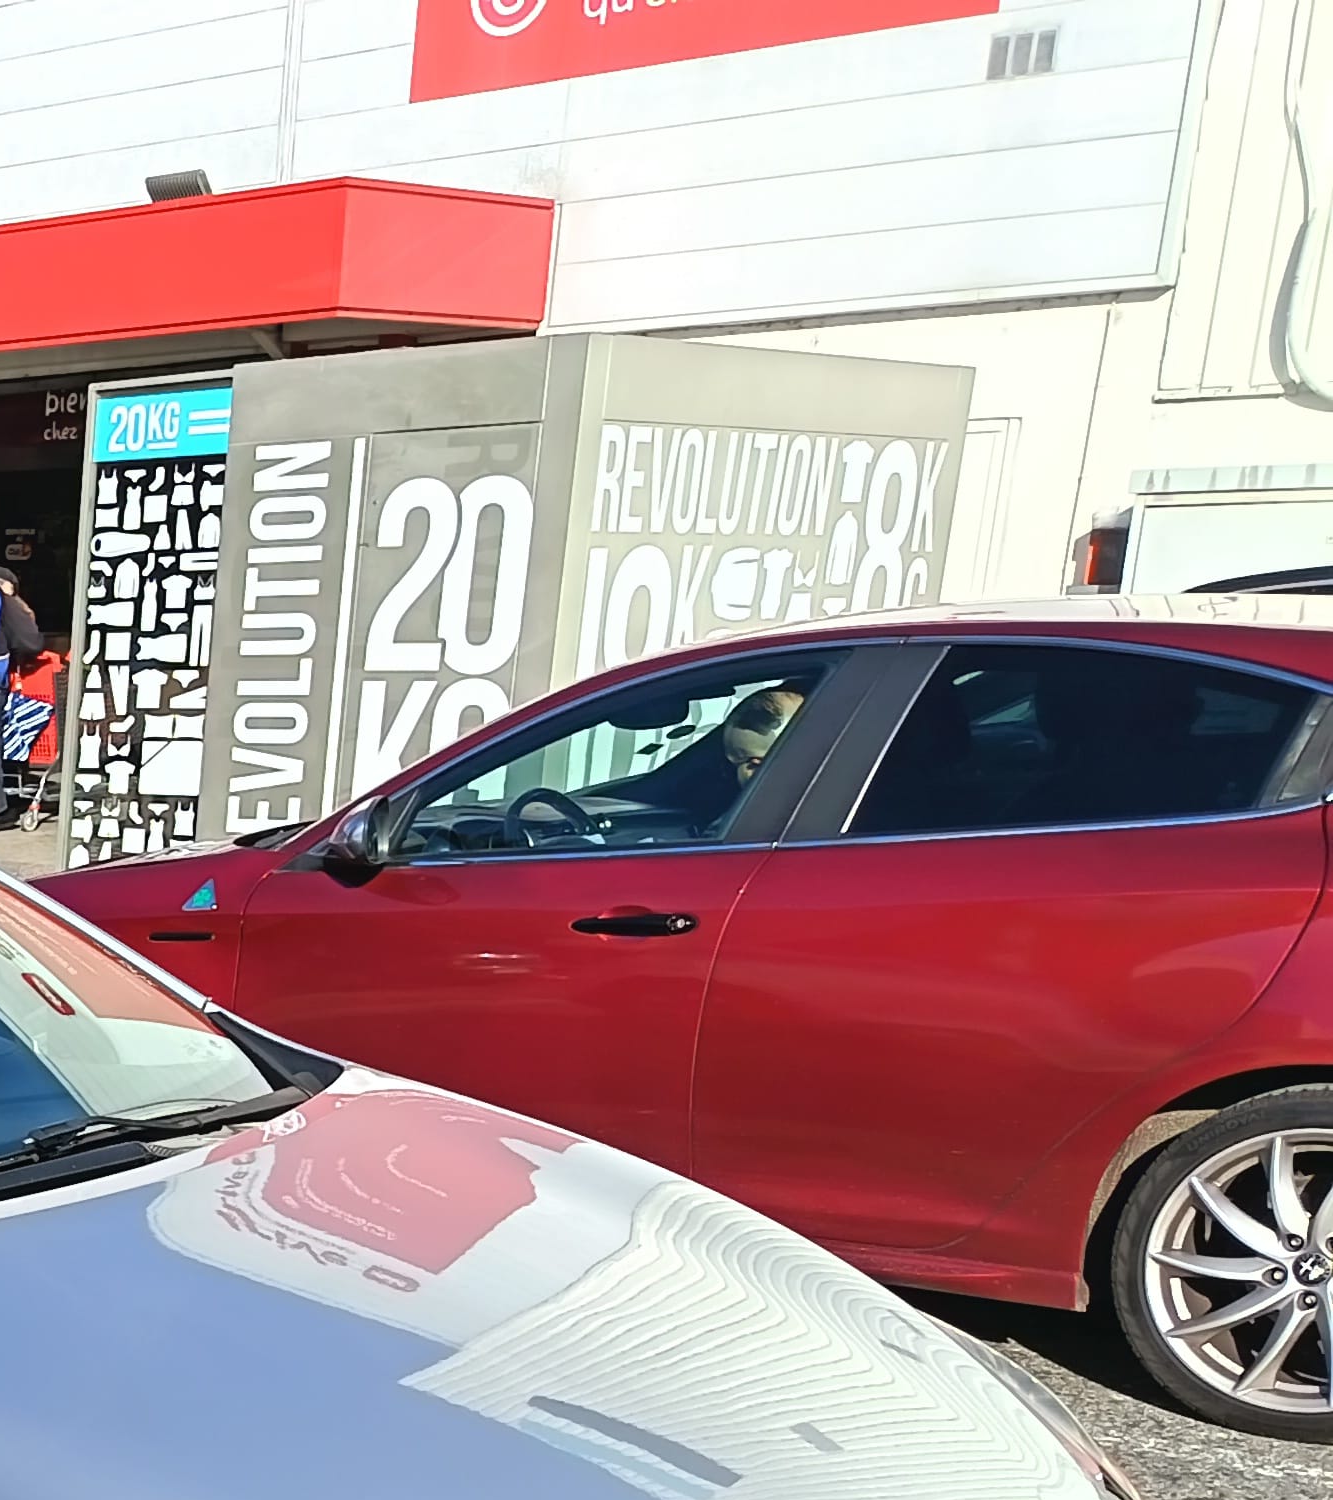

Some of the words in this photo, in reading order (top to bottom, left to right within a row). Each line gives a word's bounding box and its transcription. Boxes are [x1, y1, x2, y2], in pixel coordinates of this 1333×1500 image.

[44, 420, 78, 441] chez
[590, 424, 840, 536] REVOLUTION
[363, 474, 534, 676] 20
